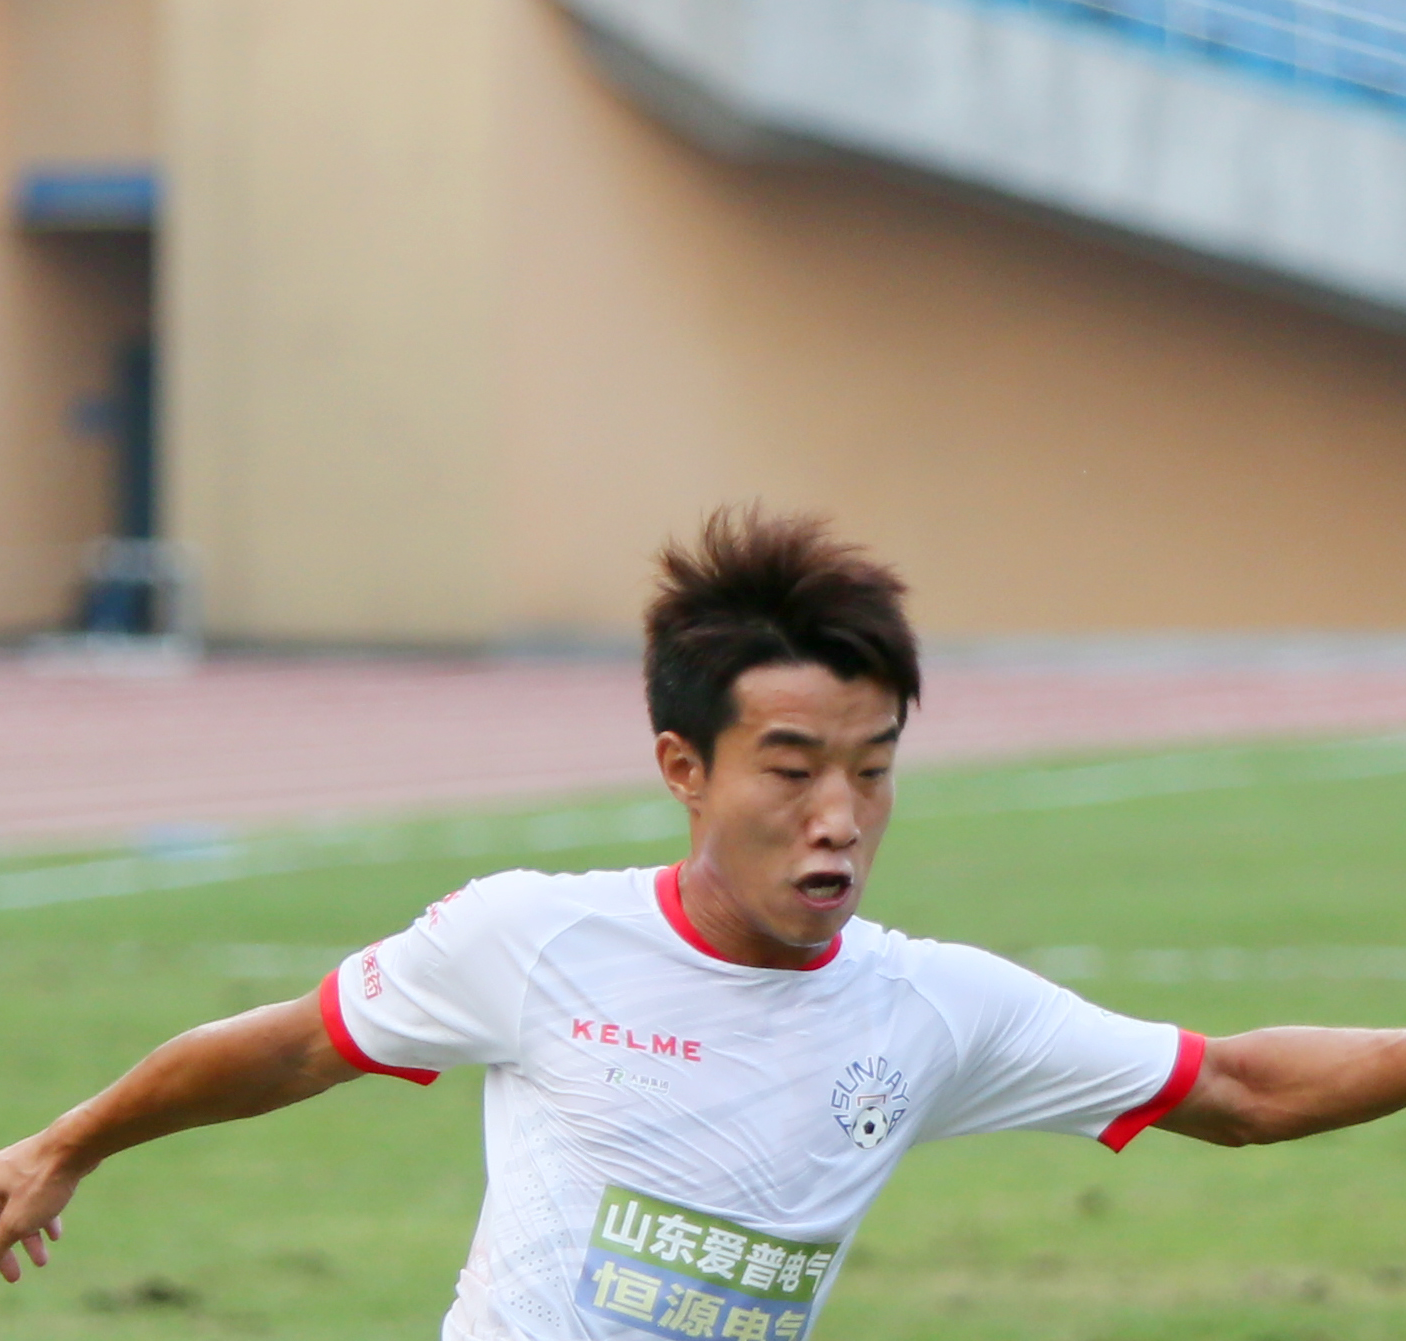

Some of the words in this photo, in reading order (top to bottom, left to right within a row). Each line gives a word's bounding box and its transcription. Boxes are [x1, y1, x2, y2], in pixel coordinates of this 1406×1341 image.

[572, 1018, 701, 1061] KELME
[601, 1200, 832, 1294] 山东爱普电气
